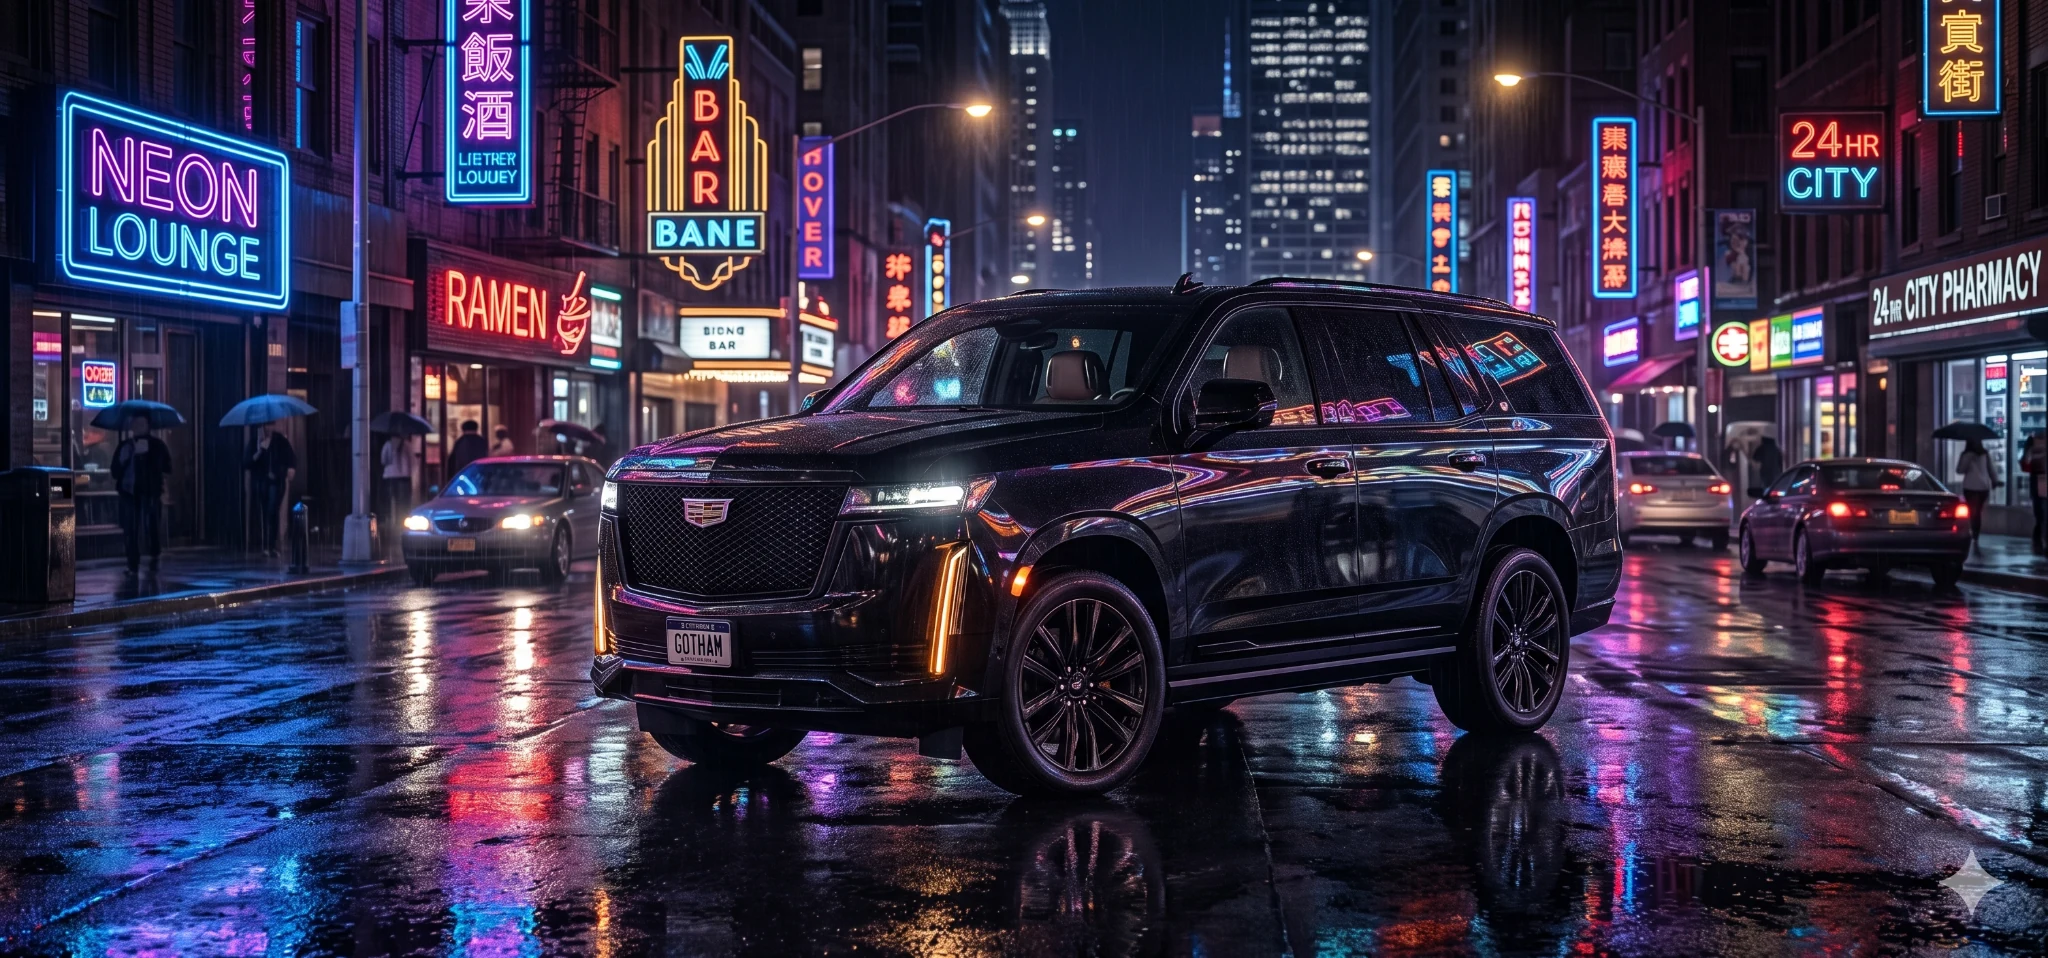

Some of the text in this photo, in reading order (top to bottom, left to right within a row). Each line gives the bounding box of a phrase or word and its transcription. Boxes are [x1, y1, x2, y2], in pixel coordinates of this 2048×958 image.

[92, 128, 257, 228] NEON
[690, 89, 721, 205] BAR
[1787, 167, 1878, 199] CITY
[89, 206, 261, 281] LOUNGE
[655, 219, 756, 247] BANE
[446, 270, 547, 340] RAMEN
[1905, 274, 1939, 321] CITY
[1942, 250, 2042, 315] PHARMACY
[709, 341, 736, 350] BAR
[674, 633, 722, 657] GOTHAM
